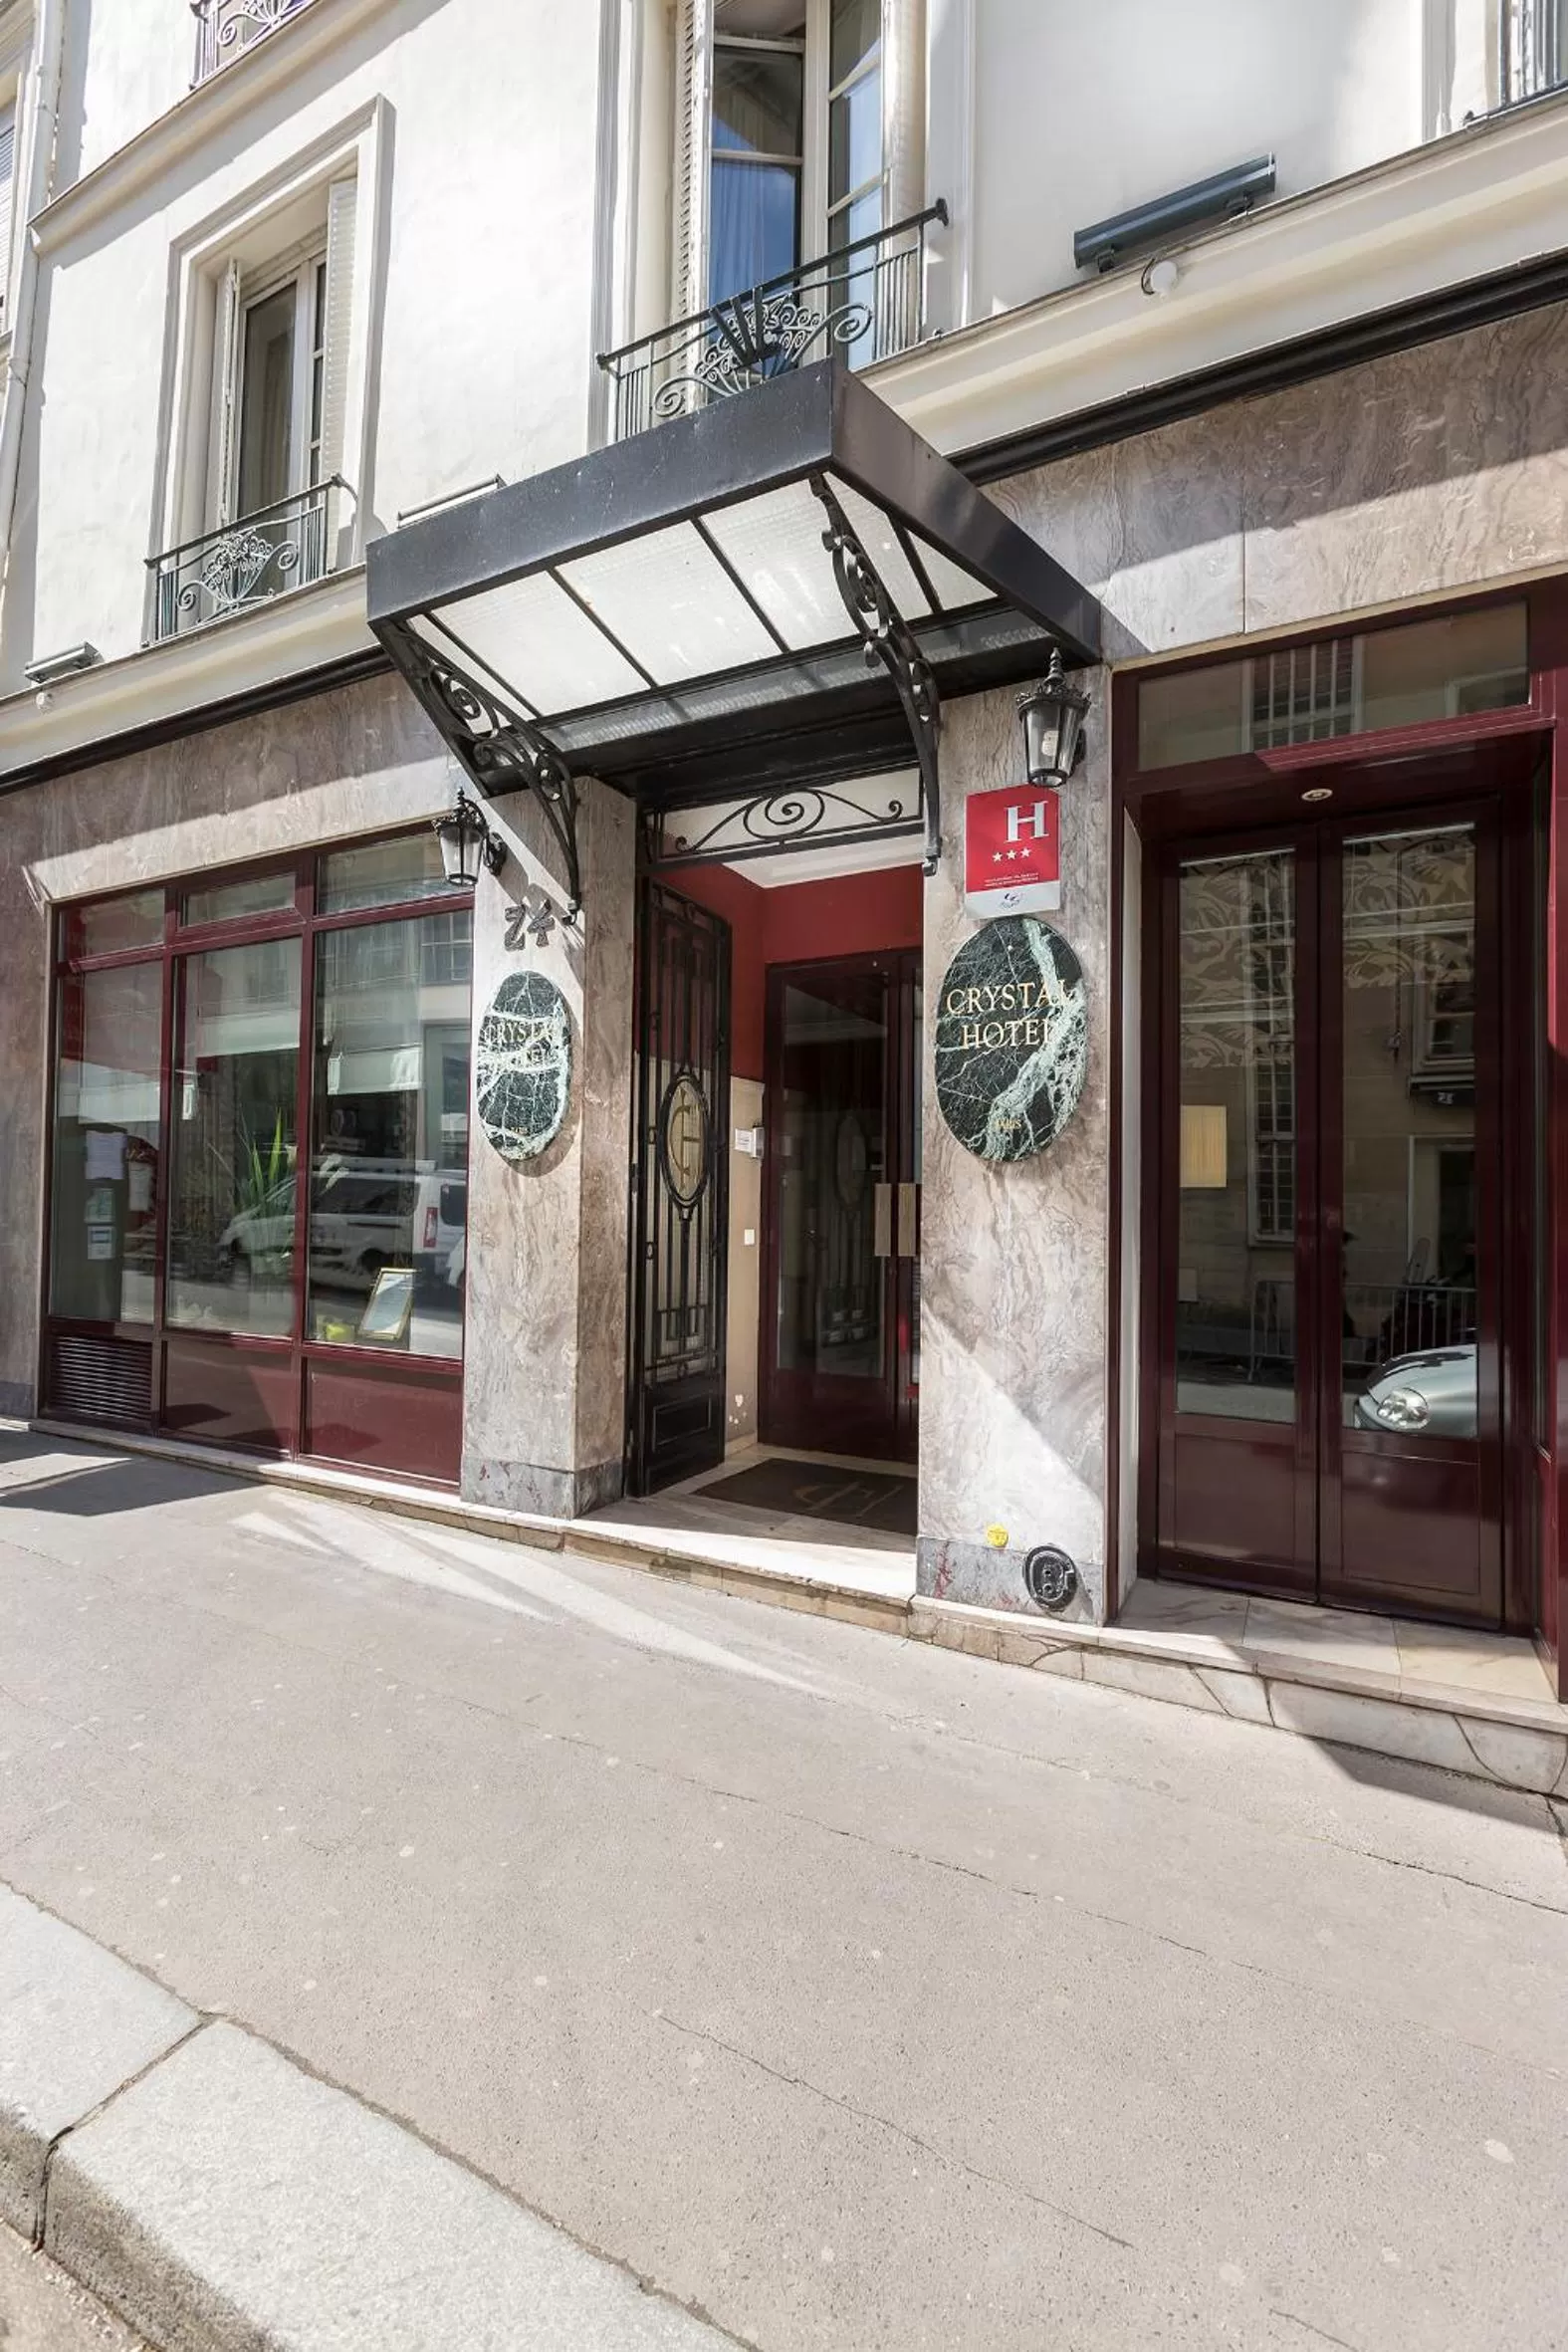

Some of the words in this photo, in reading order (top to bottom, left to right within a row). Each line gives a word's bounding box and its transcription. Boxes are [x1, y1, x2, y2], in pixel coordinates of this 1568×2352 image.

[1004, 800, 1049, 843] H
[504, 898, 556, 951] 24
[946, 979, 1074, 1015] CRYSTAL
[961, 1018, 1053, 1050] HOTEL
